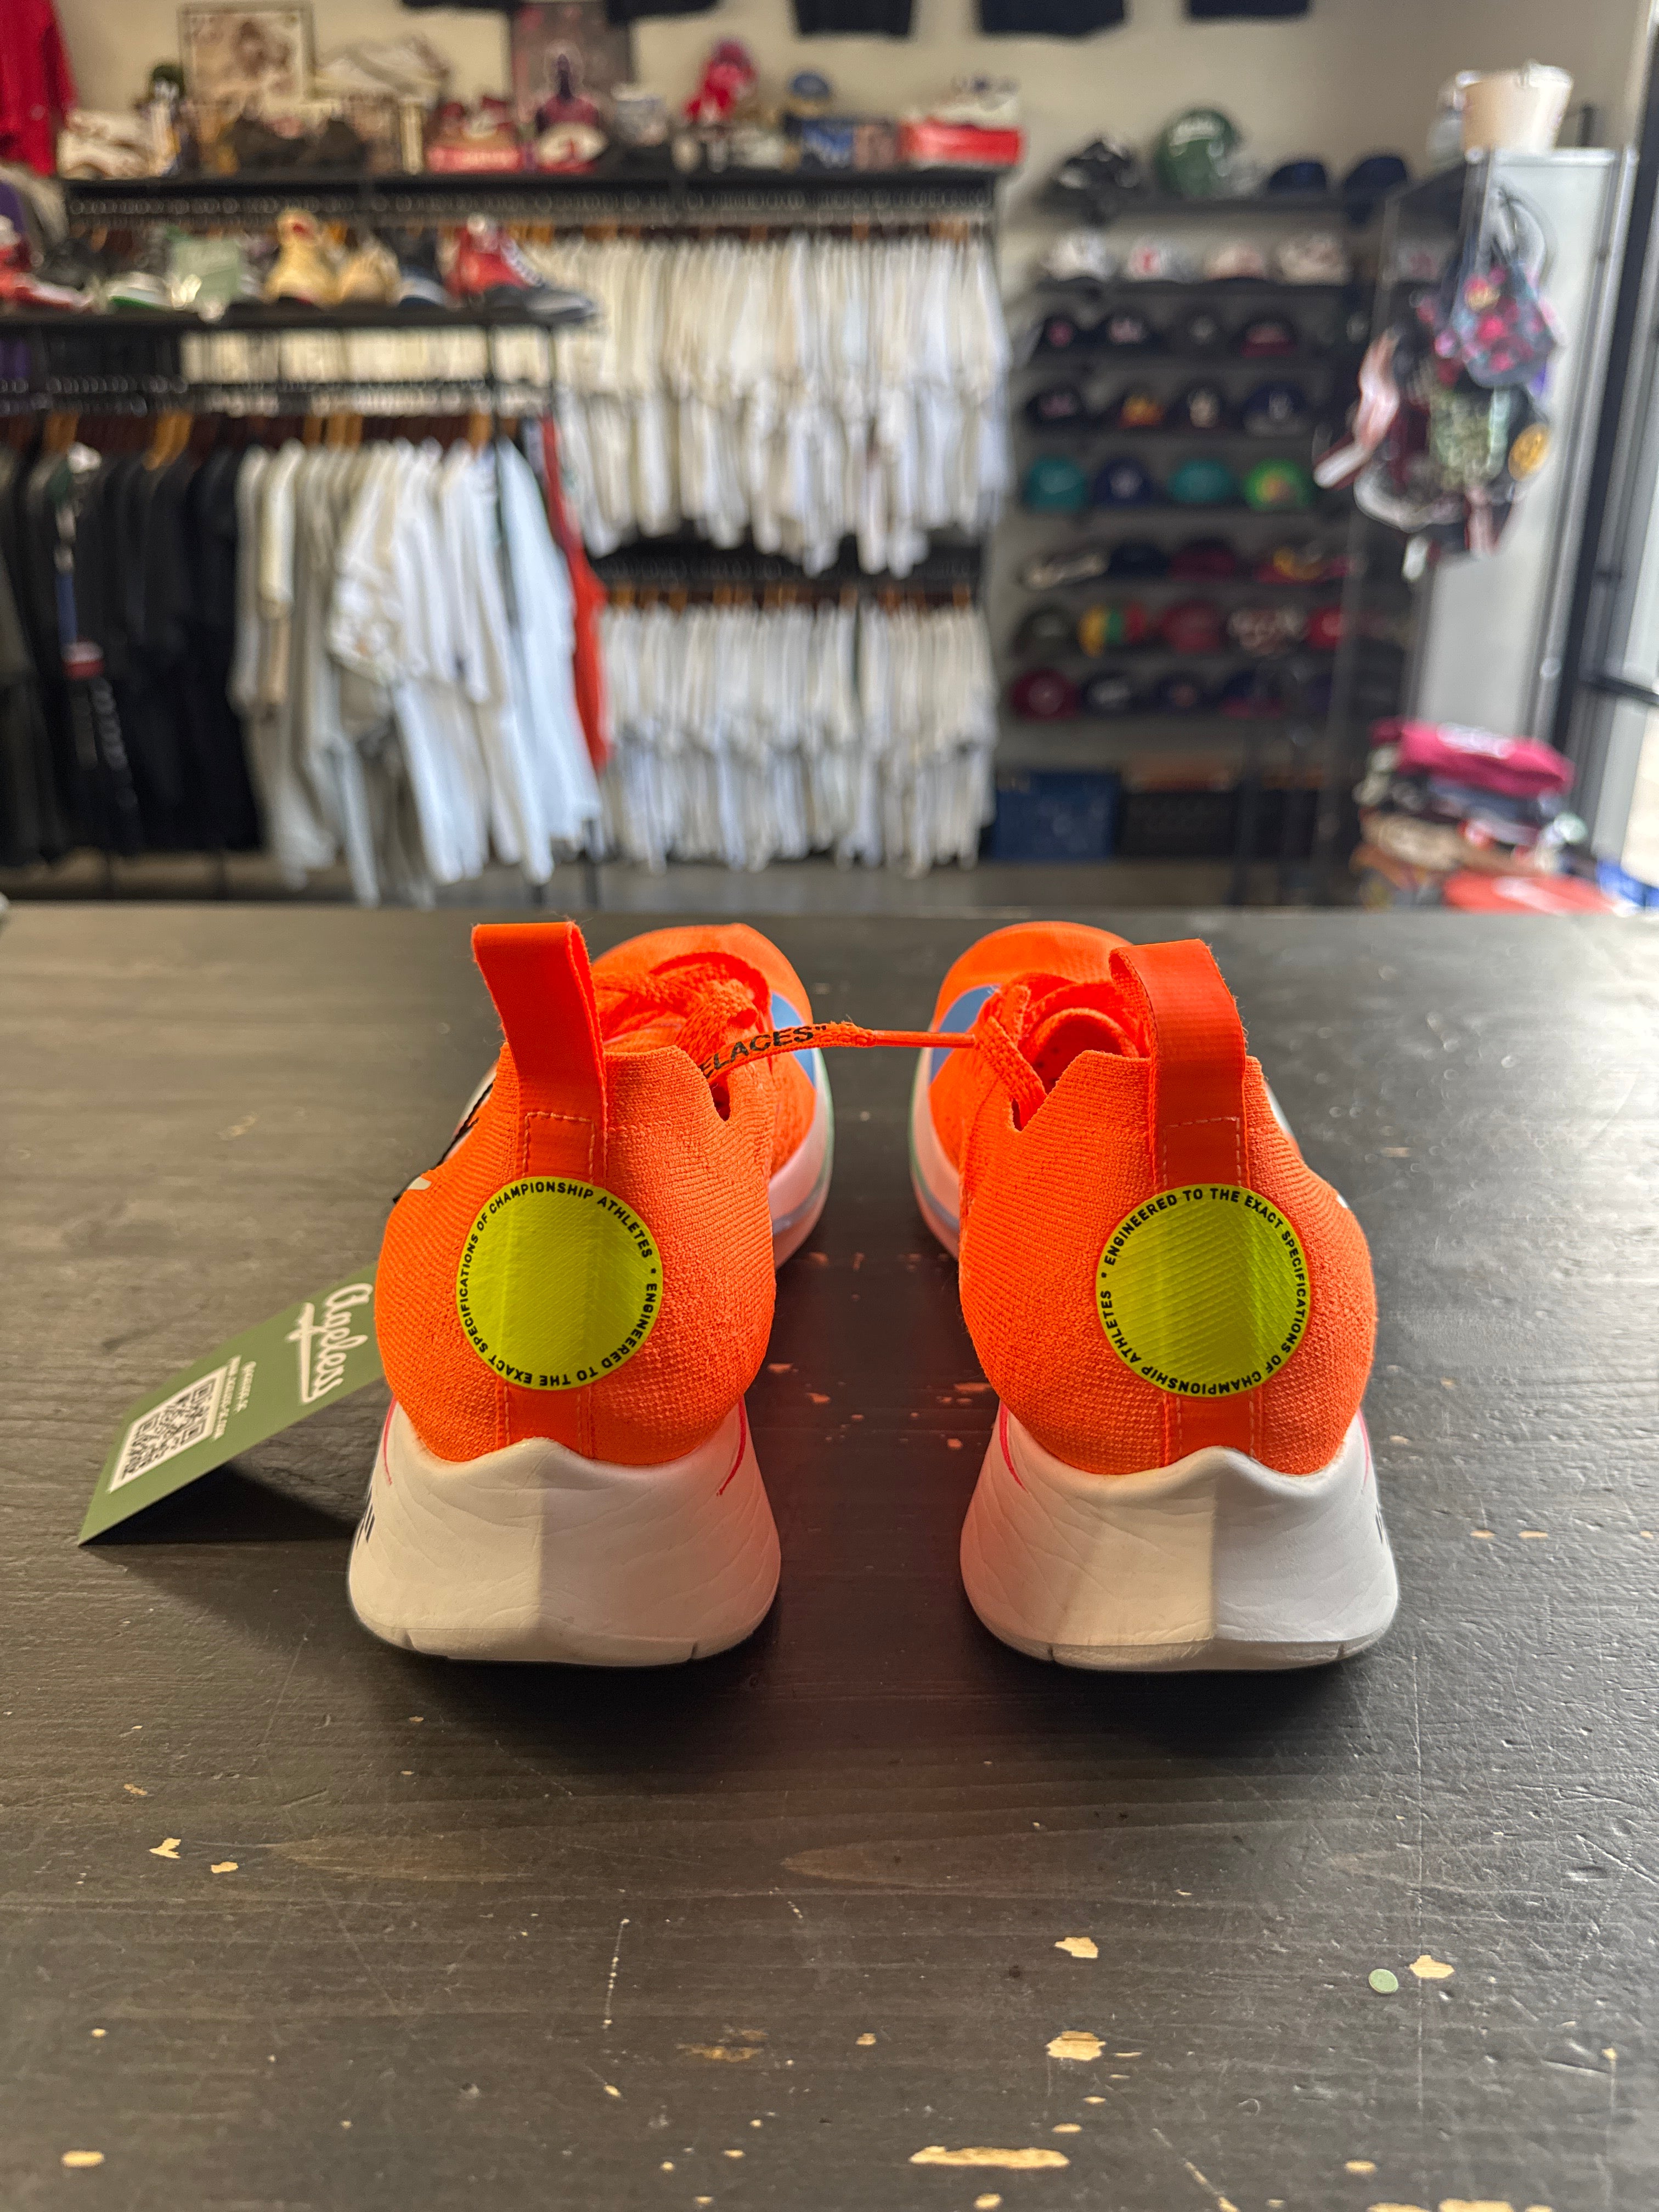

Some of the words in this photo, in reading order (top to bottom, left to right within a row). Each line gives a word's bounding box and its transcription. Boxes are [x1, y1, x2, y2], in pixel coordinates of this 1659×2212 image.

[489, 1181, 594, 1214] CHAMPIONSHIP
[1182, 1188, 1203, 1201] TO
[1209, 1188, 1240, 1203] THE
[477, 1212, 488, 1232] OF
[596, 1196, 653, 1258] ATHLETES
[1244, 1195, 1283, 1228] EXACT
[1104, 1194, 1177, 1266] ENGINEERED
[459, 1234, 488, 1353] SPECIFICATIONS
[1280, 1231, 1306, 1353] SPECIFICATIONS
[601, 1283, 657, 1369] ENGINEERED
[1100, 1290, 1142, 1363] ATHLETES
[488, 1355, 533, 1384] EXACT
[576, 1367, 599, 1381] TO
[1266, 1355, 1281, 1373] OF
[539, 1374, 571, 1387] THE
[1141, 1366, 1262, 1395] CHAMPIONSHIP
